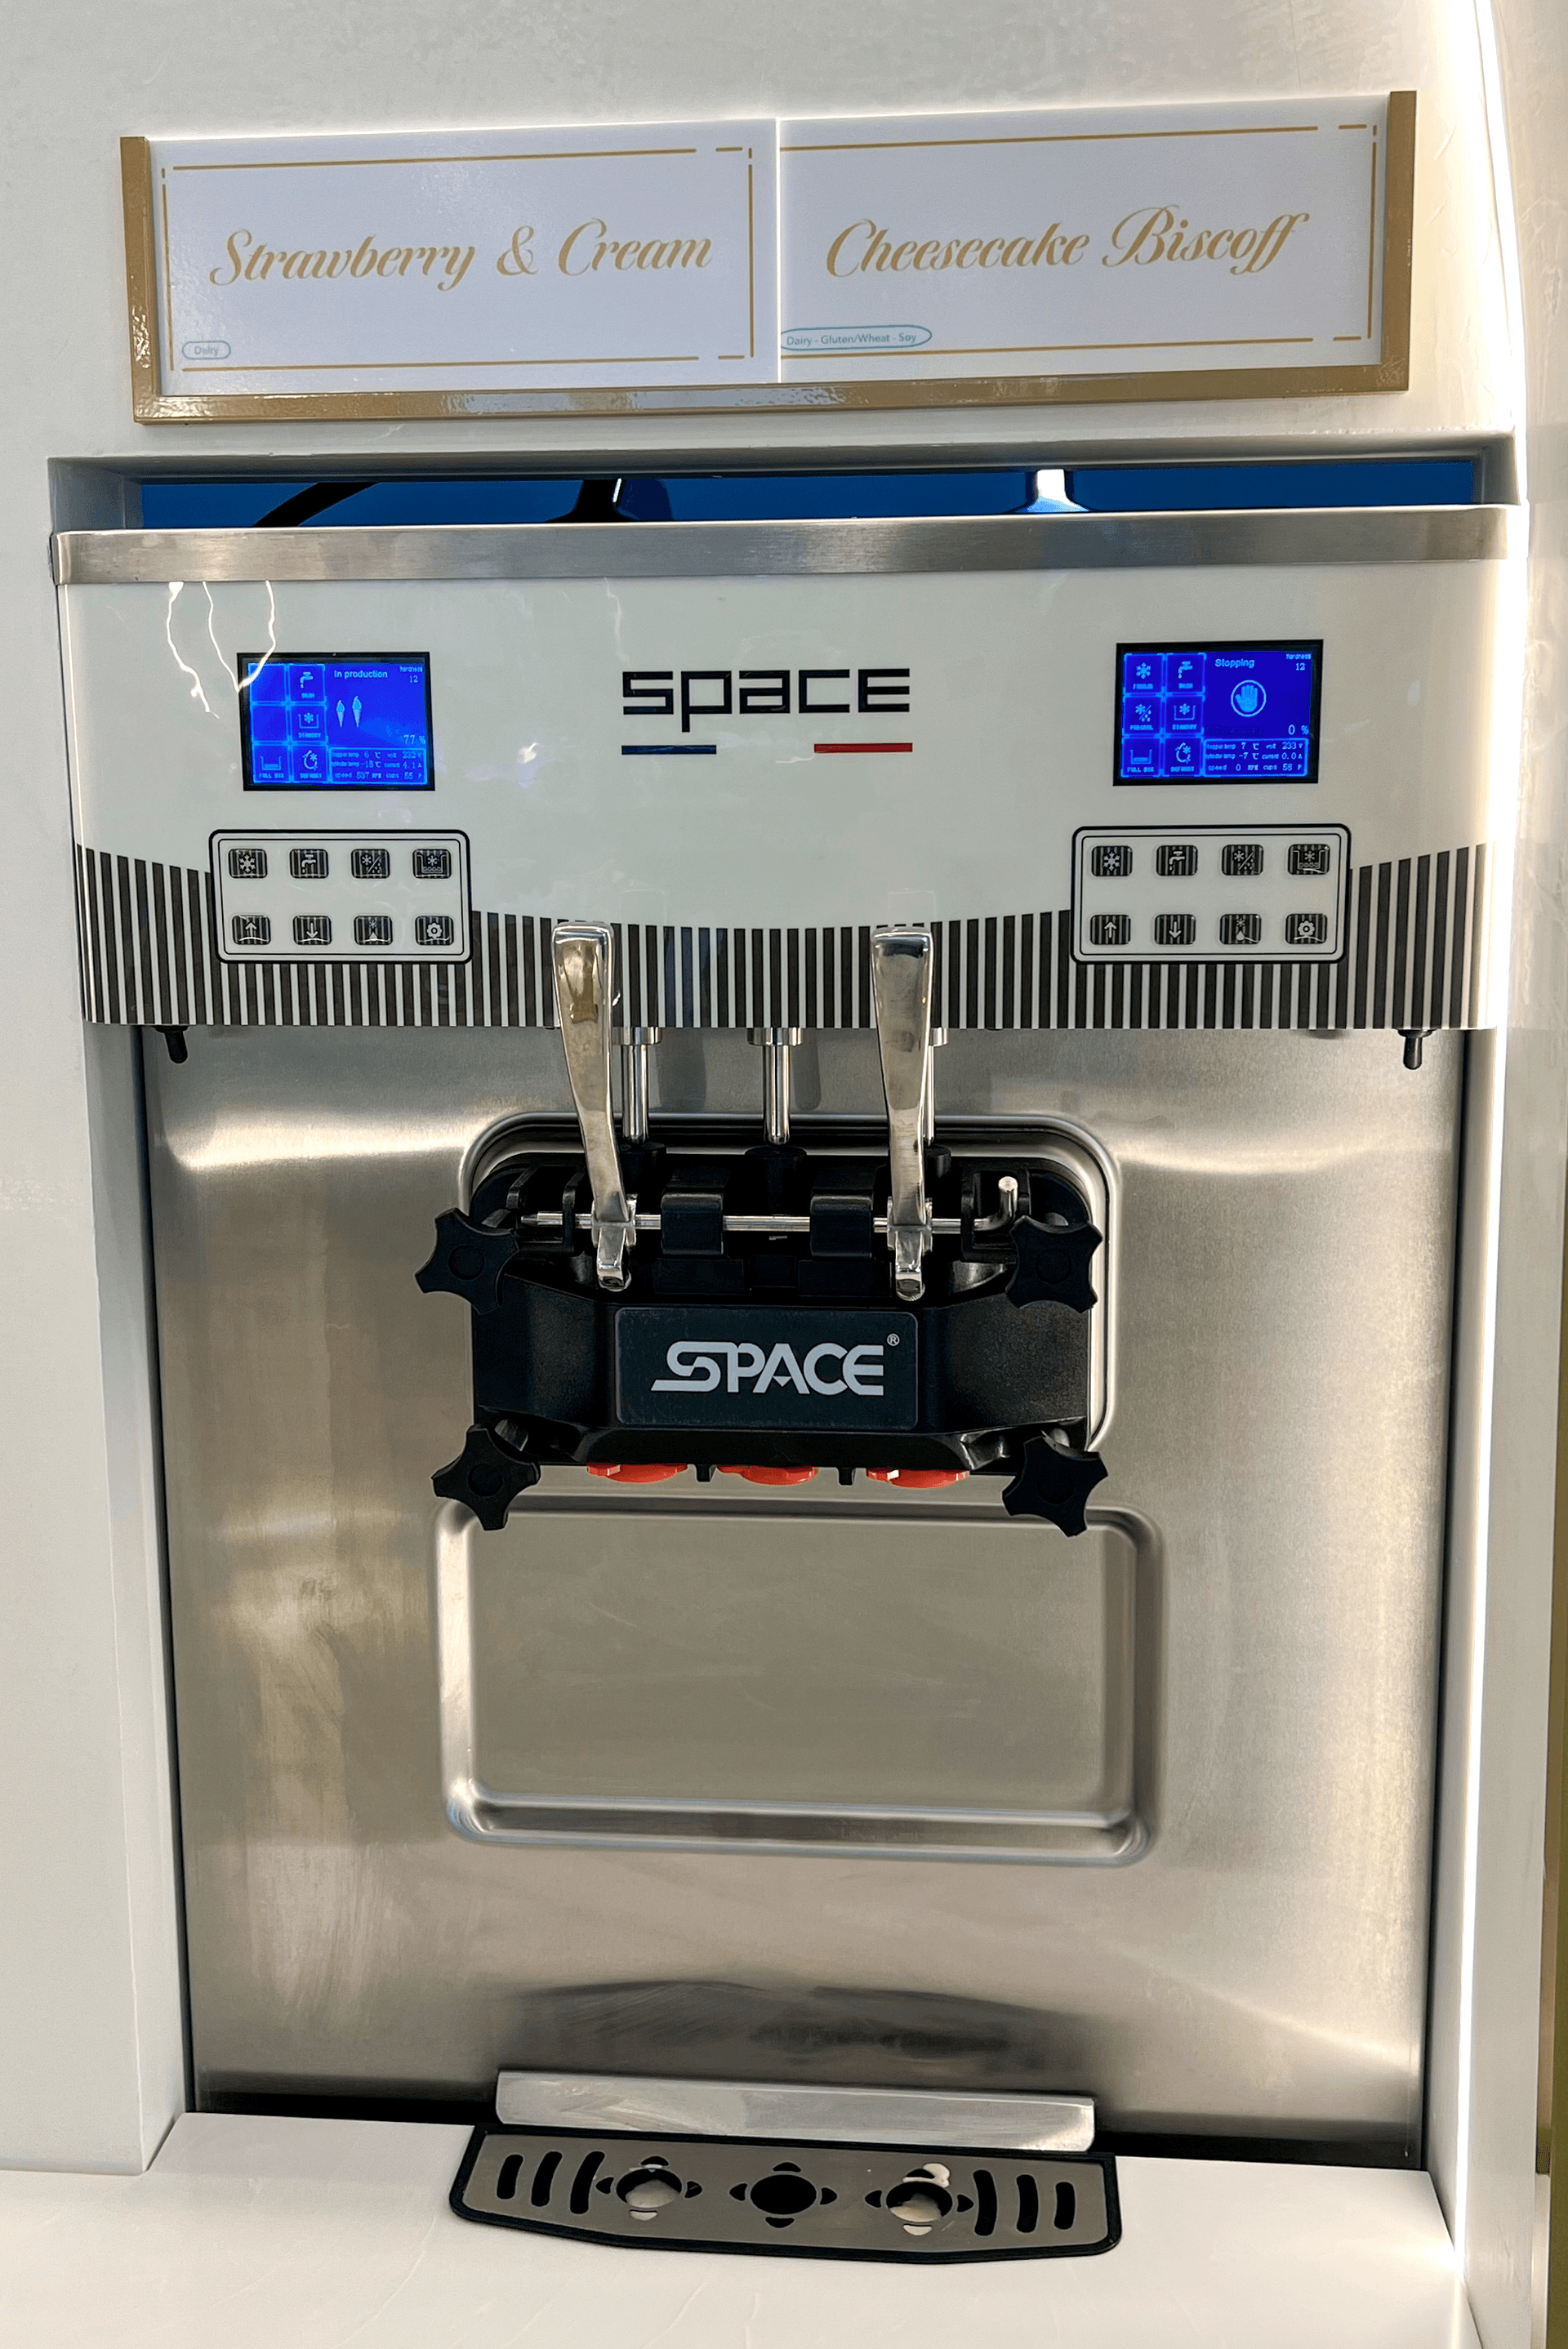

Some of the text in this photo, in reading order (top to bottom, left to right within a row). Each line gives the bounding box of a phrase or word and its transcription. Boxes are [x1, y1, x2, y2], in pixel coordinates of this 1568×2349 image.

[826, 204, 1310, 277] Cheesecake Biscoff
[209, 218, 712, 291] Strawberry & Cream
[786, 336, 812, 347] Dairy
[821, 333, 890, 345] Gluten/Wheat
[899, 332, 917, 343] Soy
[194, 345, 219, 357] Dairy
[1214, 658, 1254, 669] Stopping
[1295, 662, 1306, 671] 12
[333, 670, 388, 680] In production
[409, 675, 419, 684] 12
[1288, 724, 1309, 735] 0 %
[403, 734, 416, 745] 77
[1282, 742, 1297, 750] 233
[651, 1341, 884, 1396] SPACE
